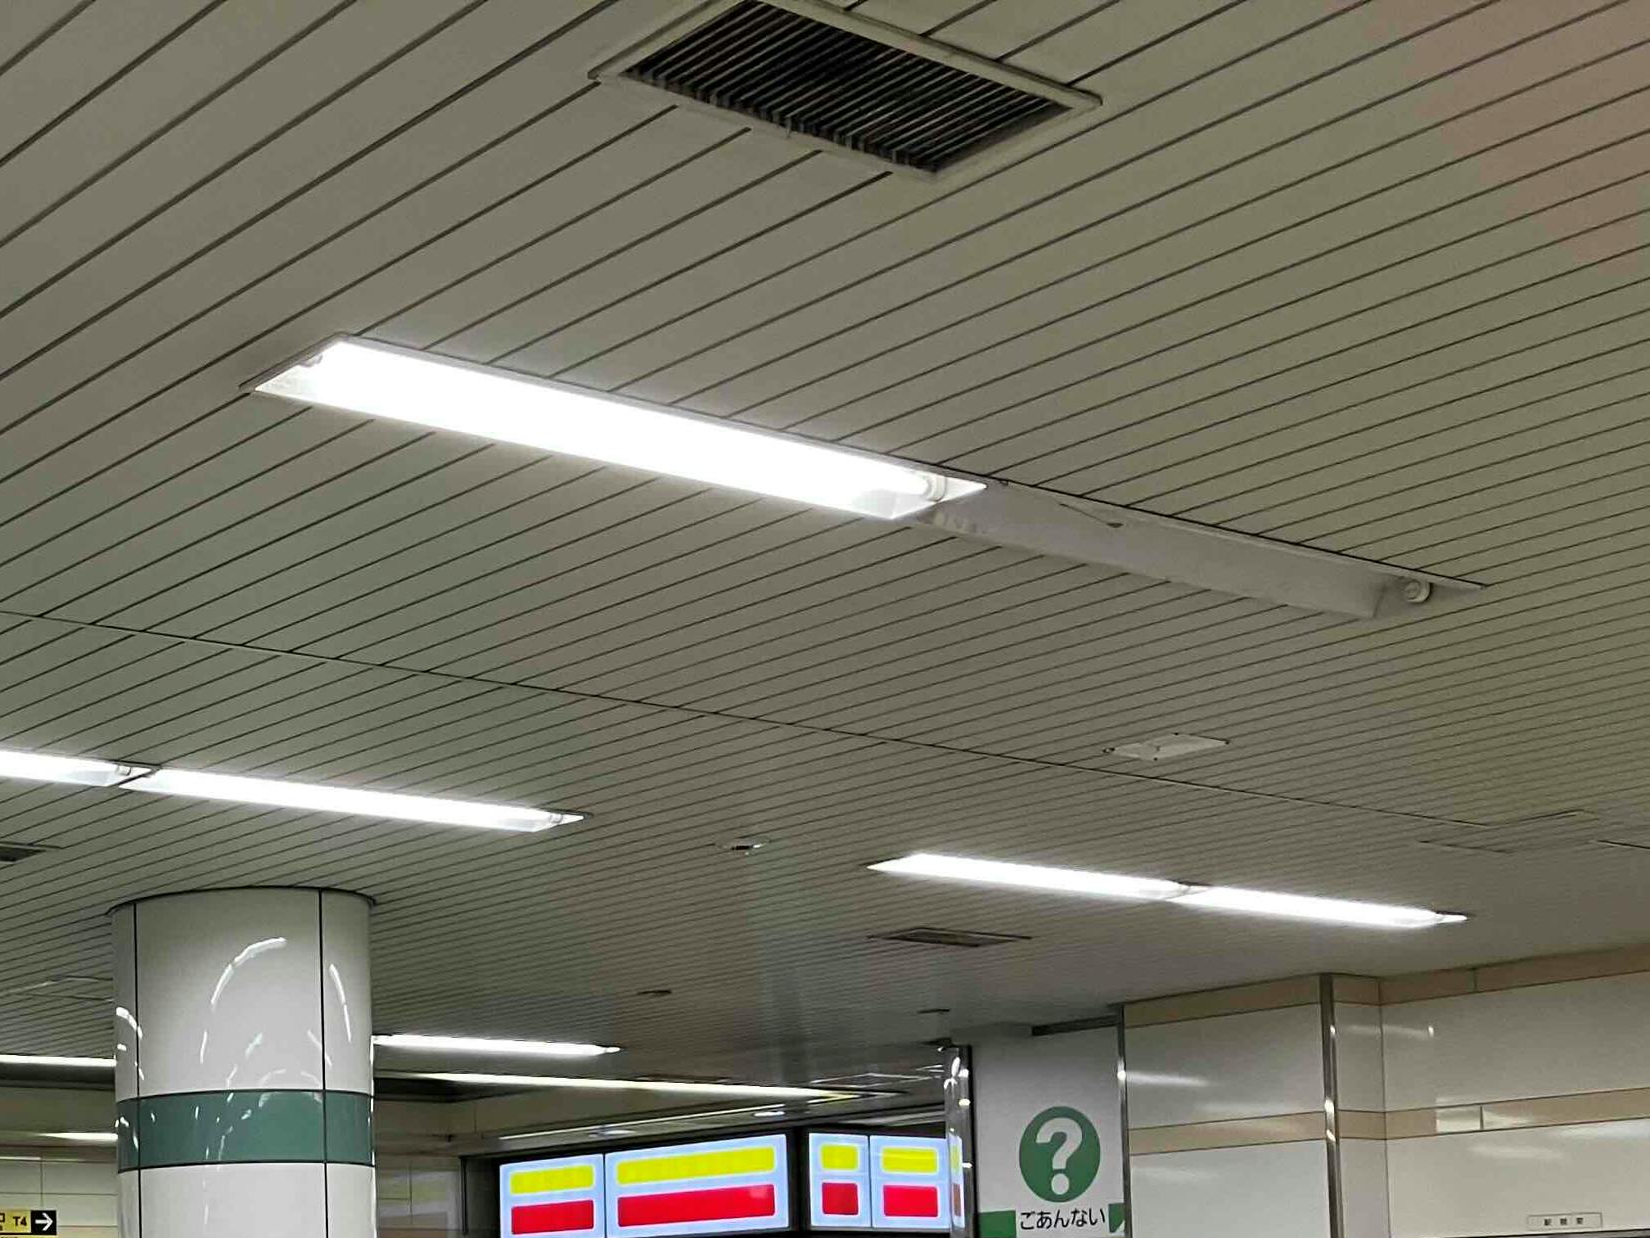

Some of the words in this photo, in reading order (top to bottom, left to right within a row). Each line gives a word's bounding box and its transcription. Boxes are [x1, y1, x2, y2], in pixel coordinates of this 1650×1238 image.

[13, 1216, 27, 1226] T4
[1020, 1207, 1105, 1230] ごあんない
